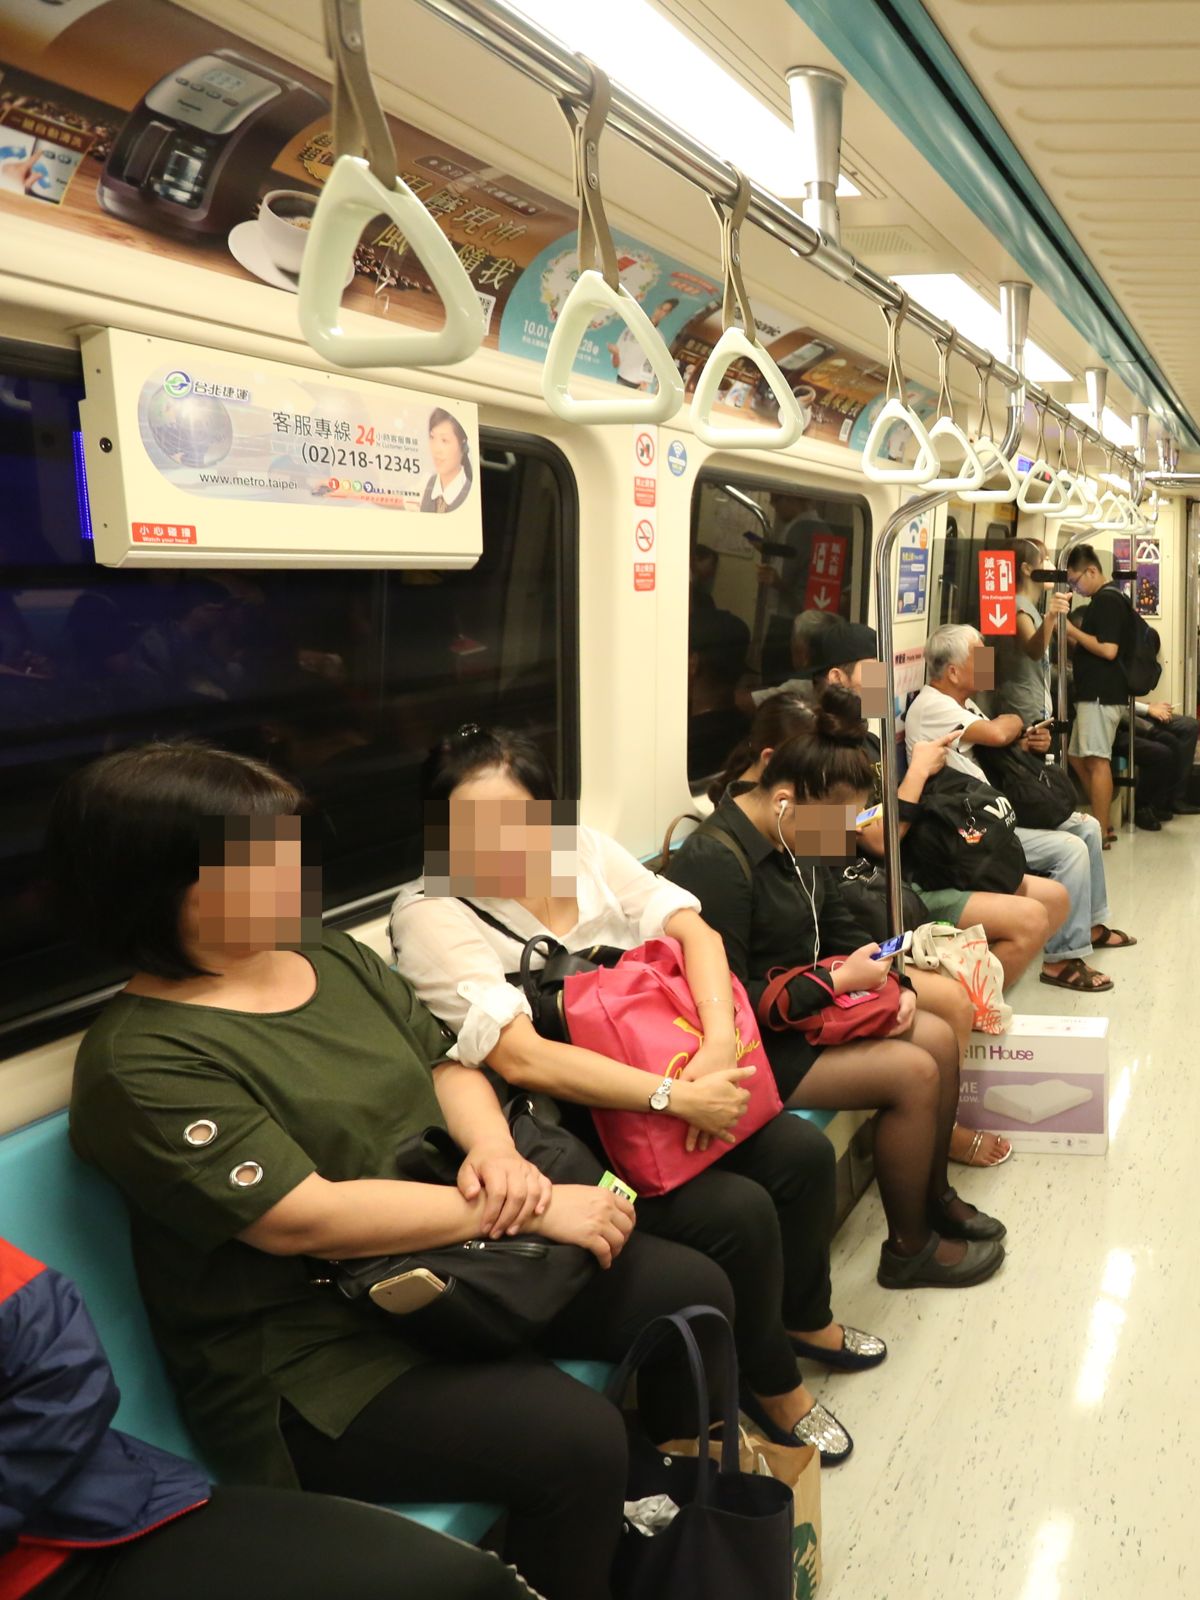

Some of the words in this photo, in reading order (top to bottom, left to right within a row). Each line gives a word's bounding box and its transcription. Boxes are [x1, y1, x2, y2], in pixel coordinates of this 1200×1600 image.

[522, 319, 549, 339] 10.01
[194, 381, 249, 400] 台北捷運
[272, 411, 352, 442] 客服專線
[355, 425, 376, 446] 24
[302, 442, 421, 474] (02)218-12345
[199, 473, 298, 490] www.metro.taipei
[989, 1045, 1034, 1061] House
